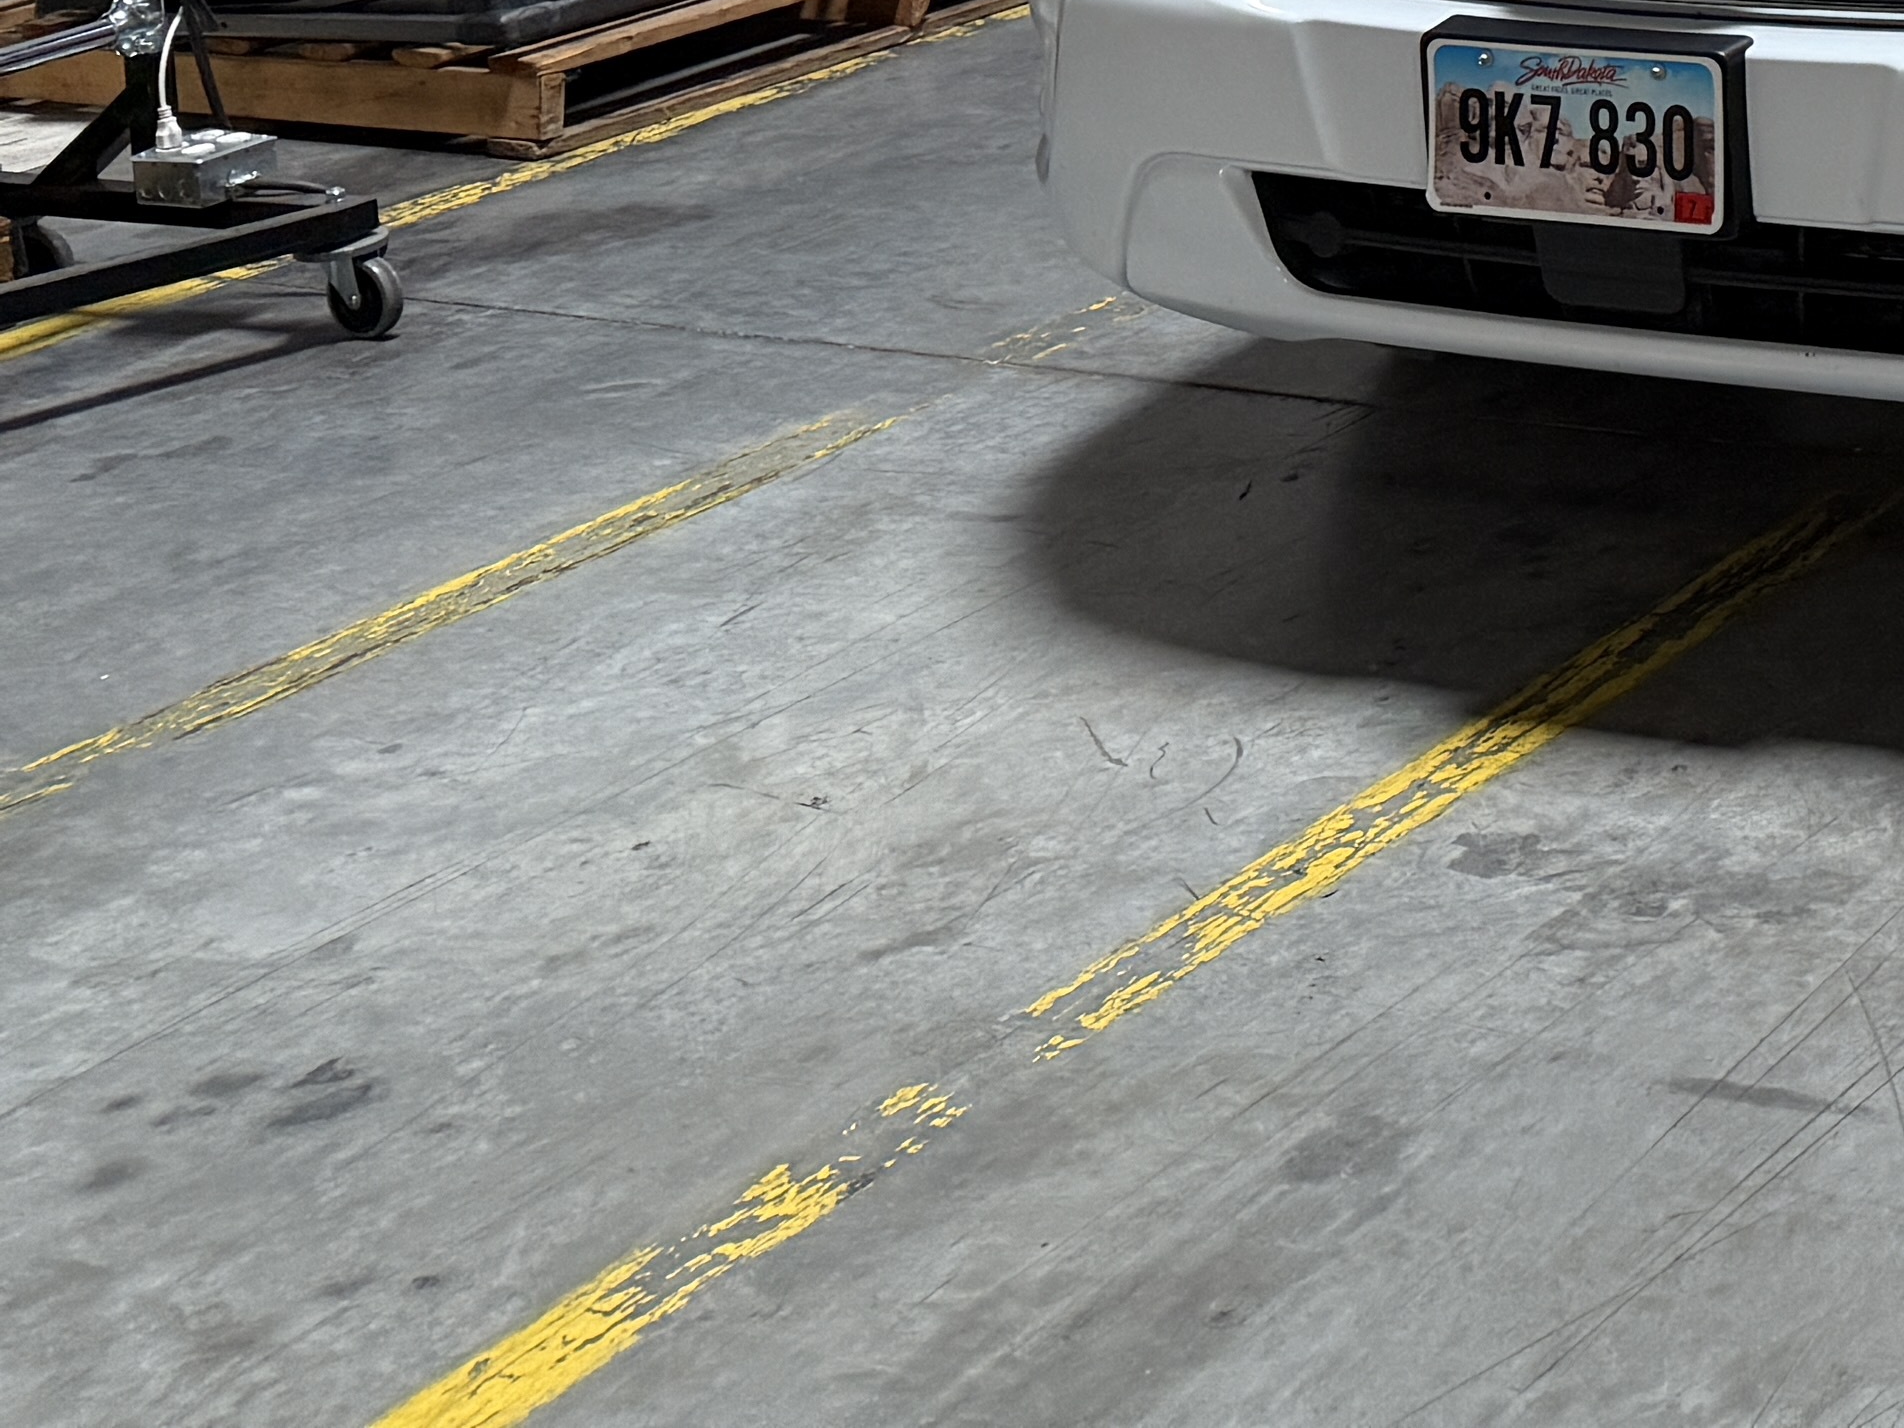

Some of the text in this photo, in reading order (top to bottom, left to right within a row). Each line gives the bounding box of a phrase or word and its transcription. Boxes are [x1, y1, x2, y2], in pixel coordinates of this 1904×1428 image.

[1515, 55, 1627, 86] South Dakota
[1458, 87, 1695, 182] 9K7 830
